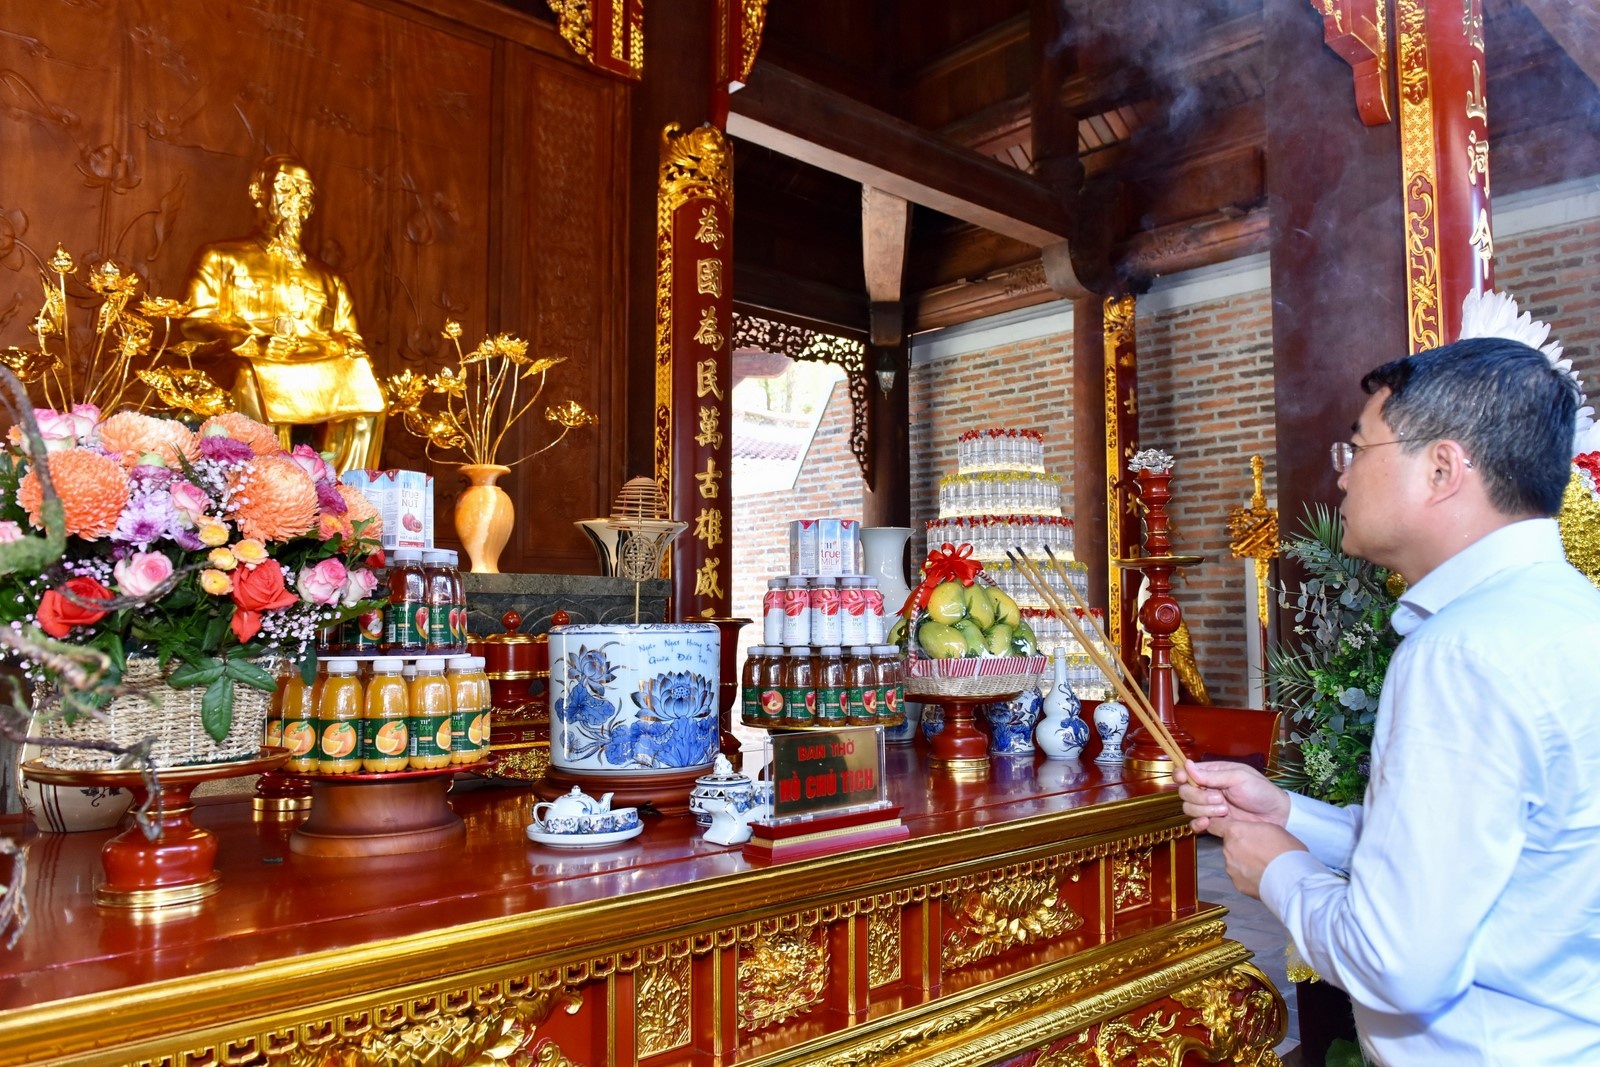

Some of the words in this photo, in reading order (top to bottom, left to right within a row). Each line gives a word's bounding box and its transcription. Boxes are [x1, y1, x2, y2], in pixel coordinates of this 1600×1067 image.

[693, 204, 725, 617] 為國為民萬古雄威
[401, 490, 419, 499] true
[401, 499, 419, 508] NUT
[820, 549, 841, 558] true
[798, 744, 826, 761] BAN
[830, 739, 855, 757] THỜ
[779, 770, 801, 803] HỒ
[805, 768, 837, 799] CHỦ
[841, 767, 874, 796] TỊCH
